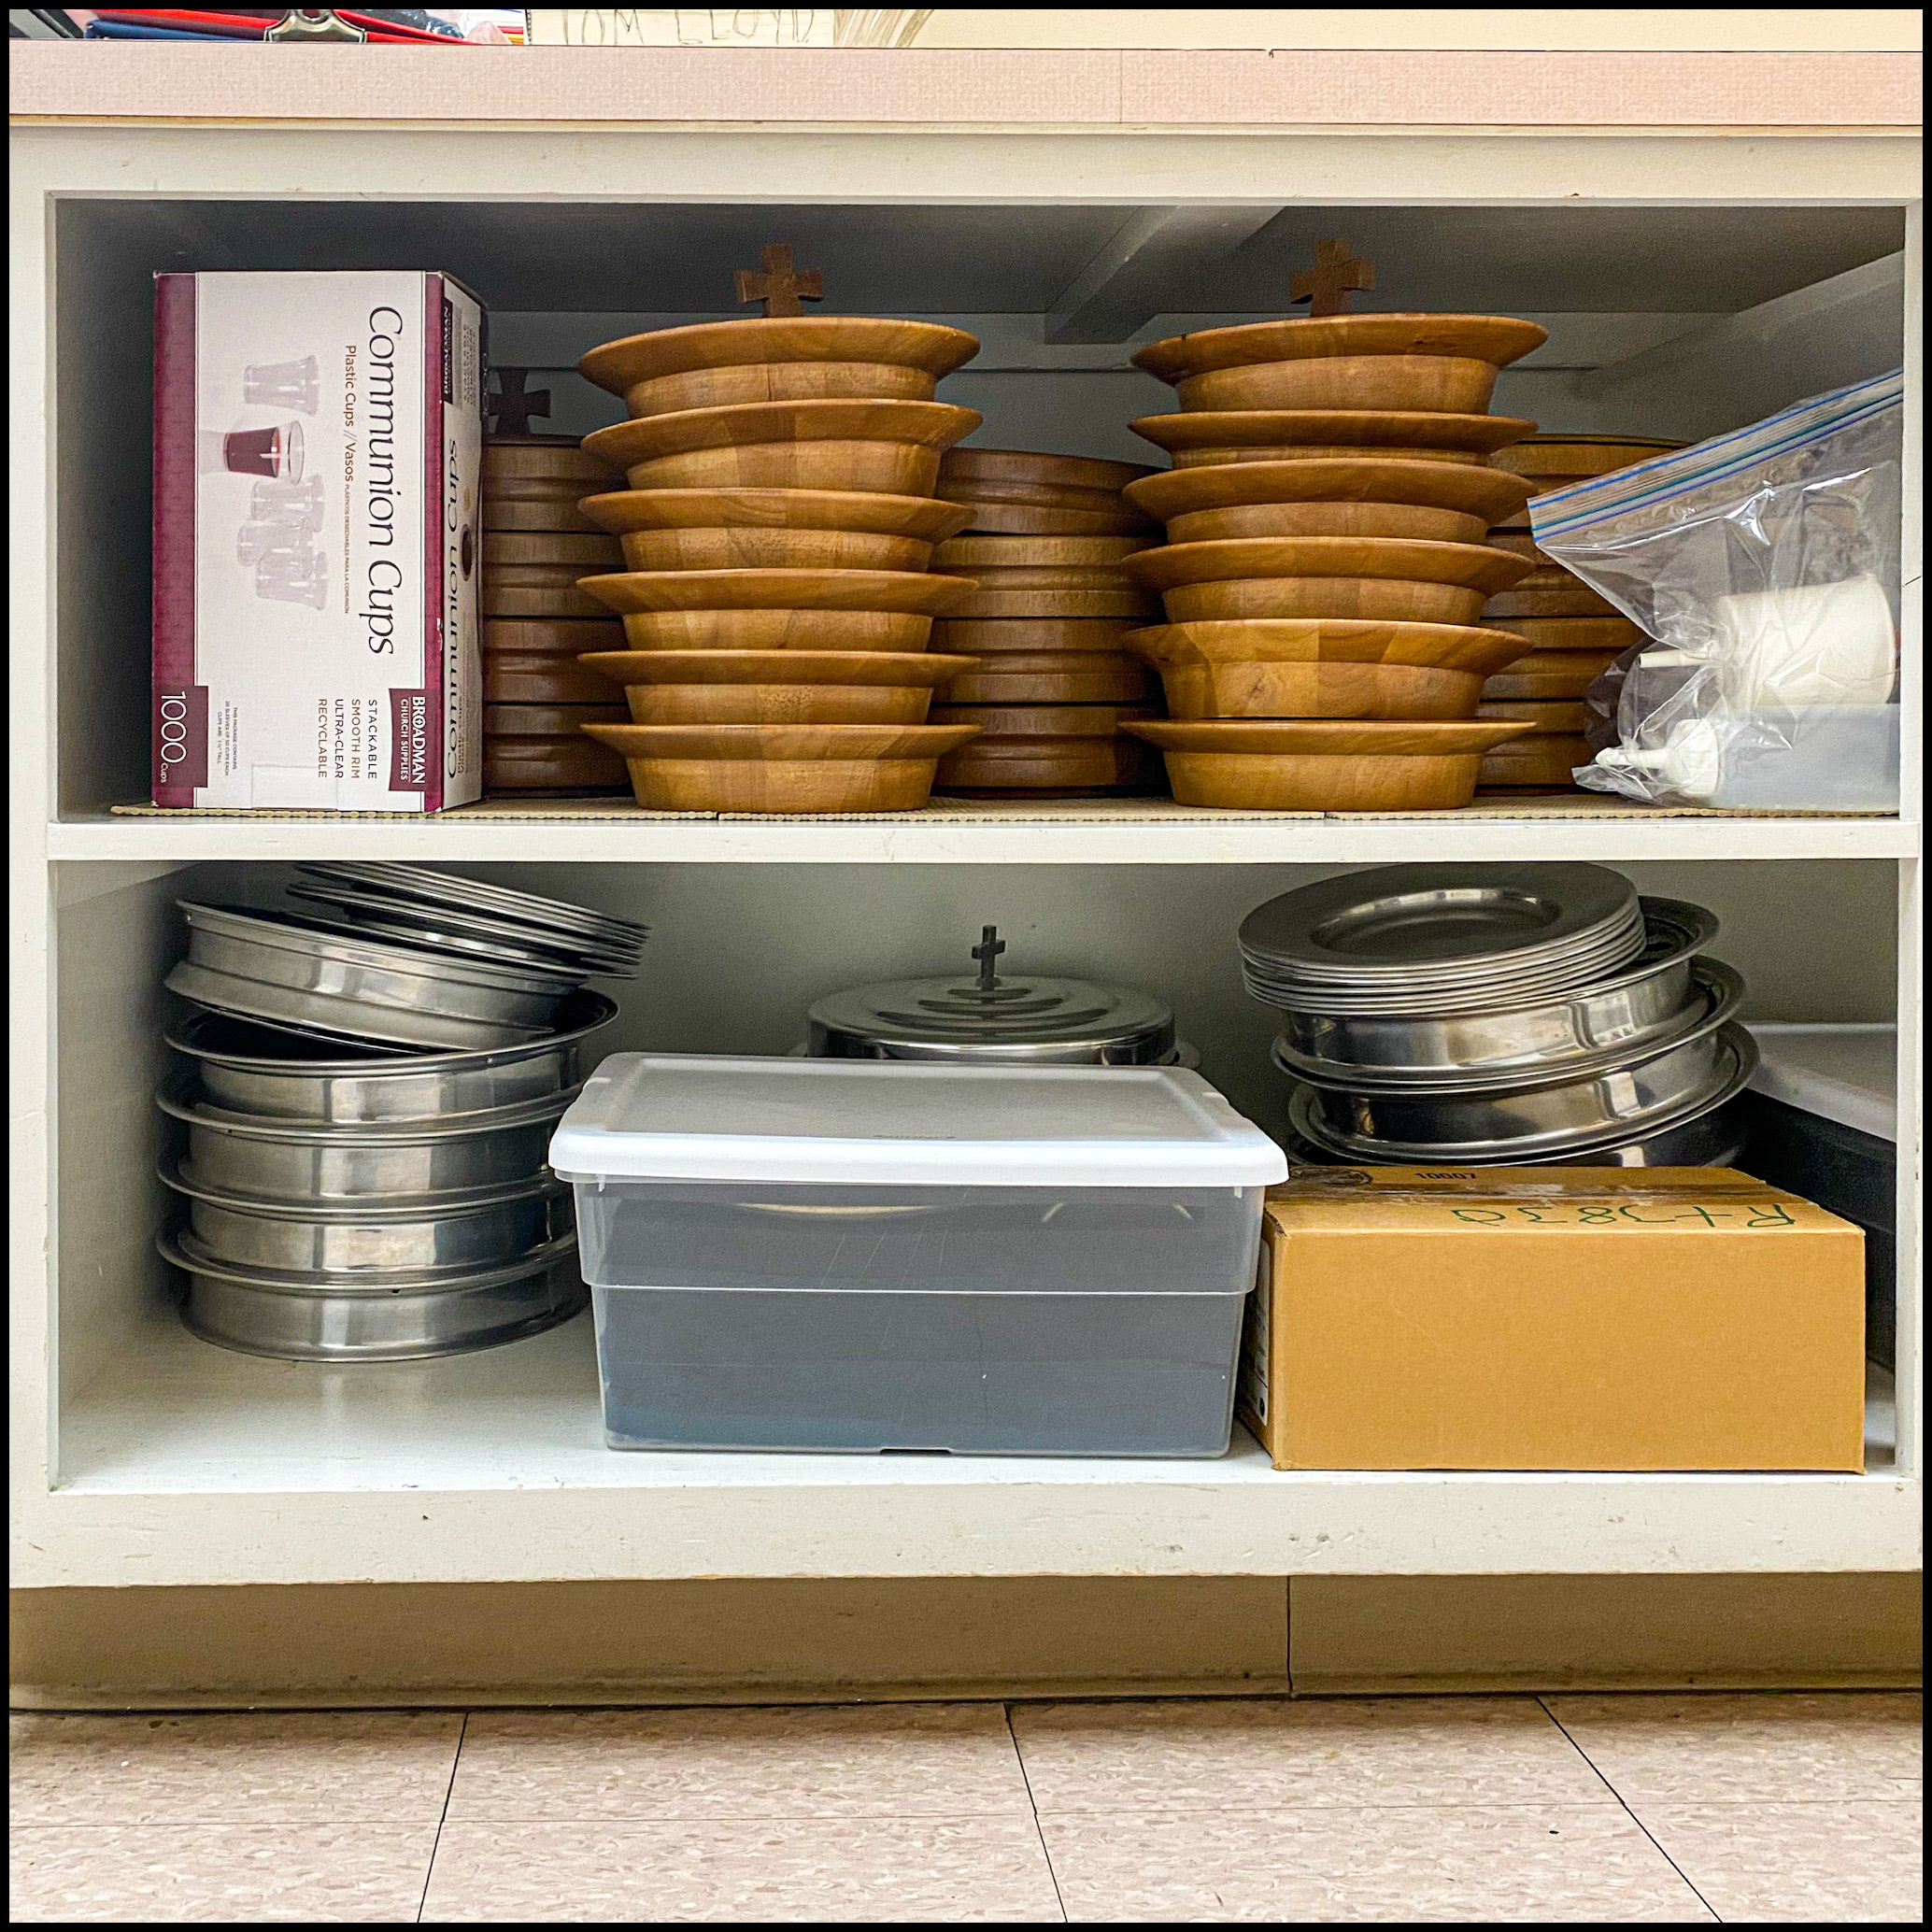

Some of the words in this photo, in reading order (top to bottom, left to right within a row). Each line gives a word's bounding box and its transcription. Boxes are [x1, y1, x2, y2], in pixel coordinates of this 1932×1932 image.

[344, 345, 357, 390] Plastic
[343, 392, 357, 427] Cups
[368, 305, 404, 547] Communion
[345, 443, 356, 481] Vasos
[447, 439, 459, 533] Cups
[359, 560, 404, 655] Cups
[447, 546, 458, 779] Communion
[160, 691, 187, 762] 1000
[318, 699, 328, 778] RECYCLABLE
[334, 699, 344, 778] ULTRA-CLEAR
[351, 699, 361, 752] SMOOTH
[367, 699, 377, 779] STACKABLE
[400, 699, 408, 738] CHURCH
[412, 696, 426, 784] BROADMAN
[160, 762, 169, 783] Cups
[351, 757, 361, 779] RIM
[400, 740, 408, 780] SUPPLIES
